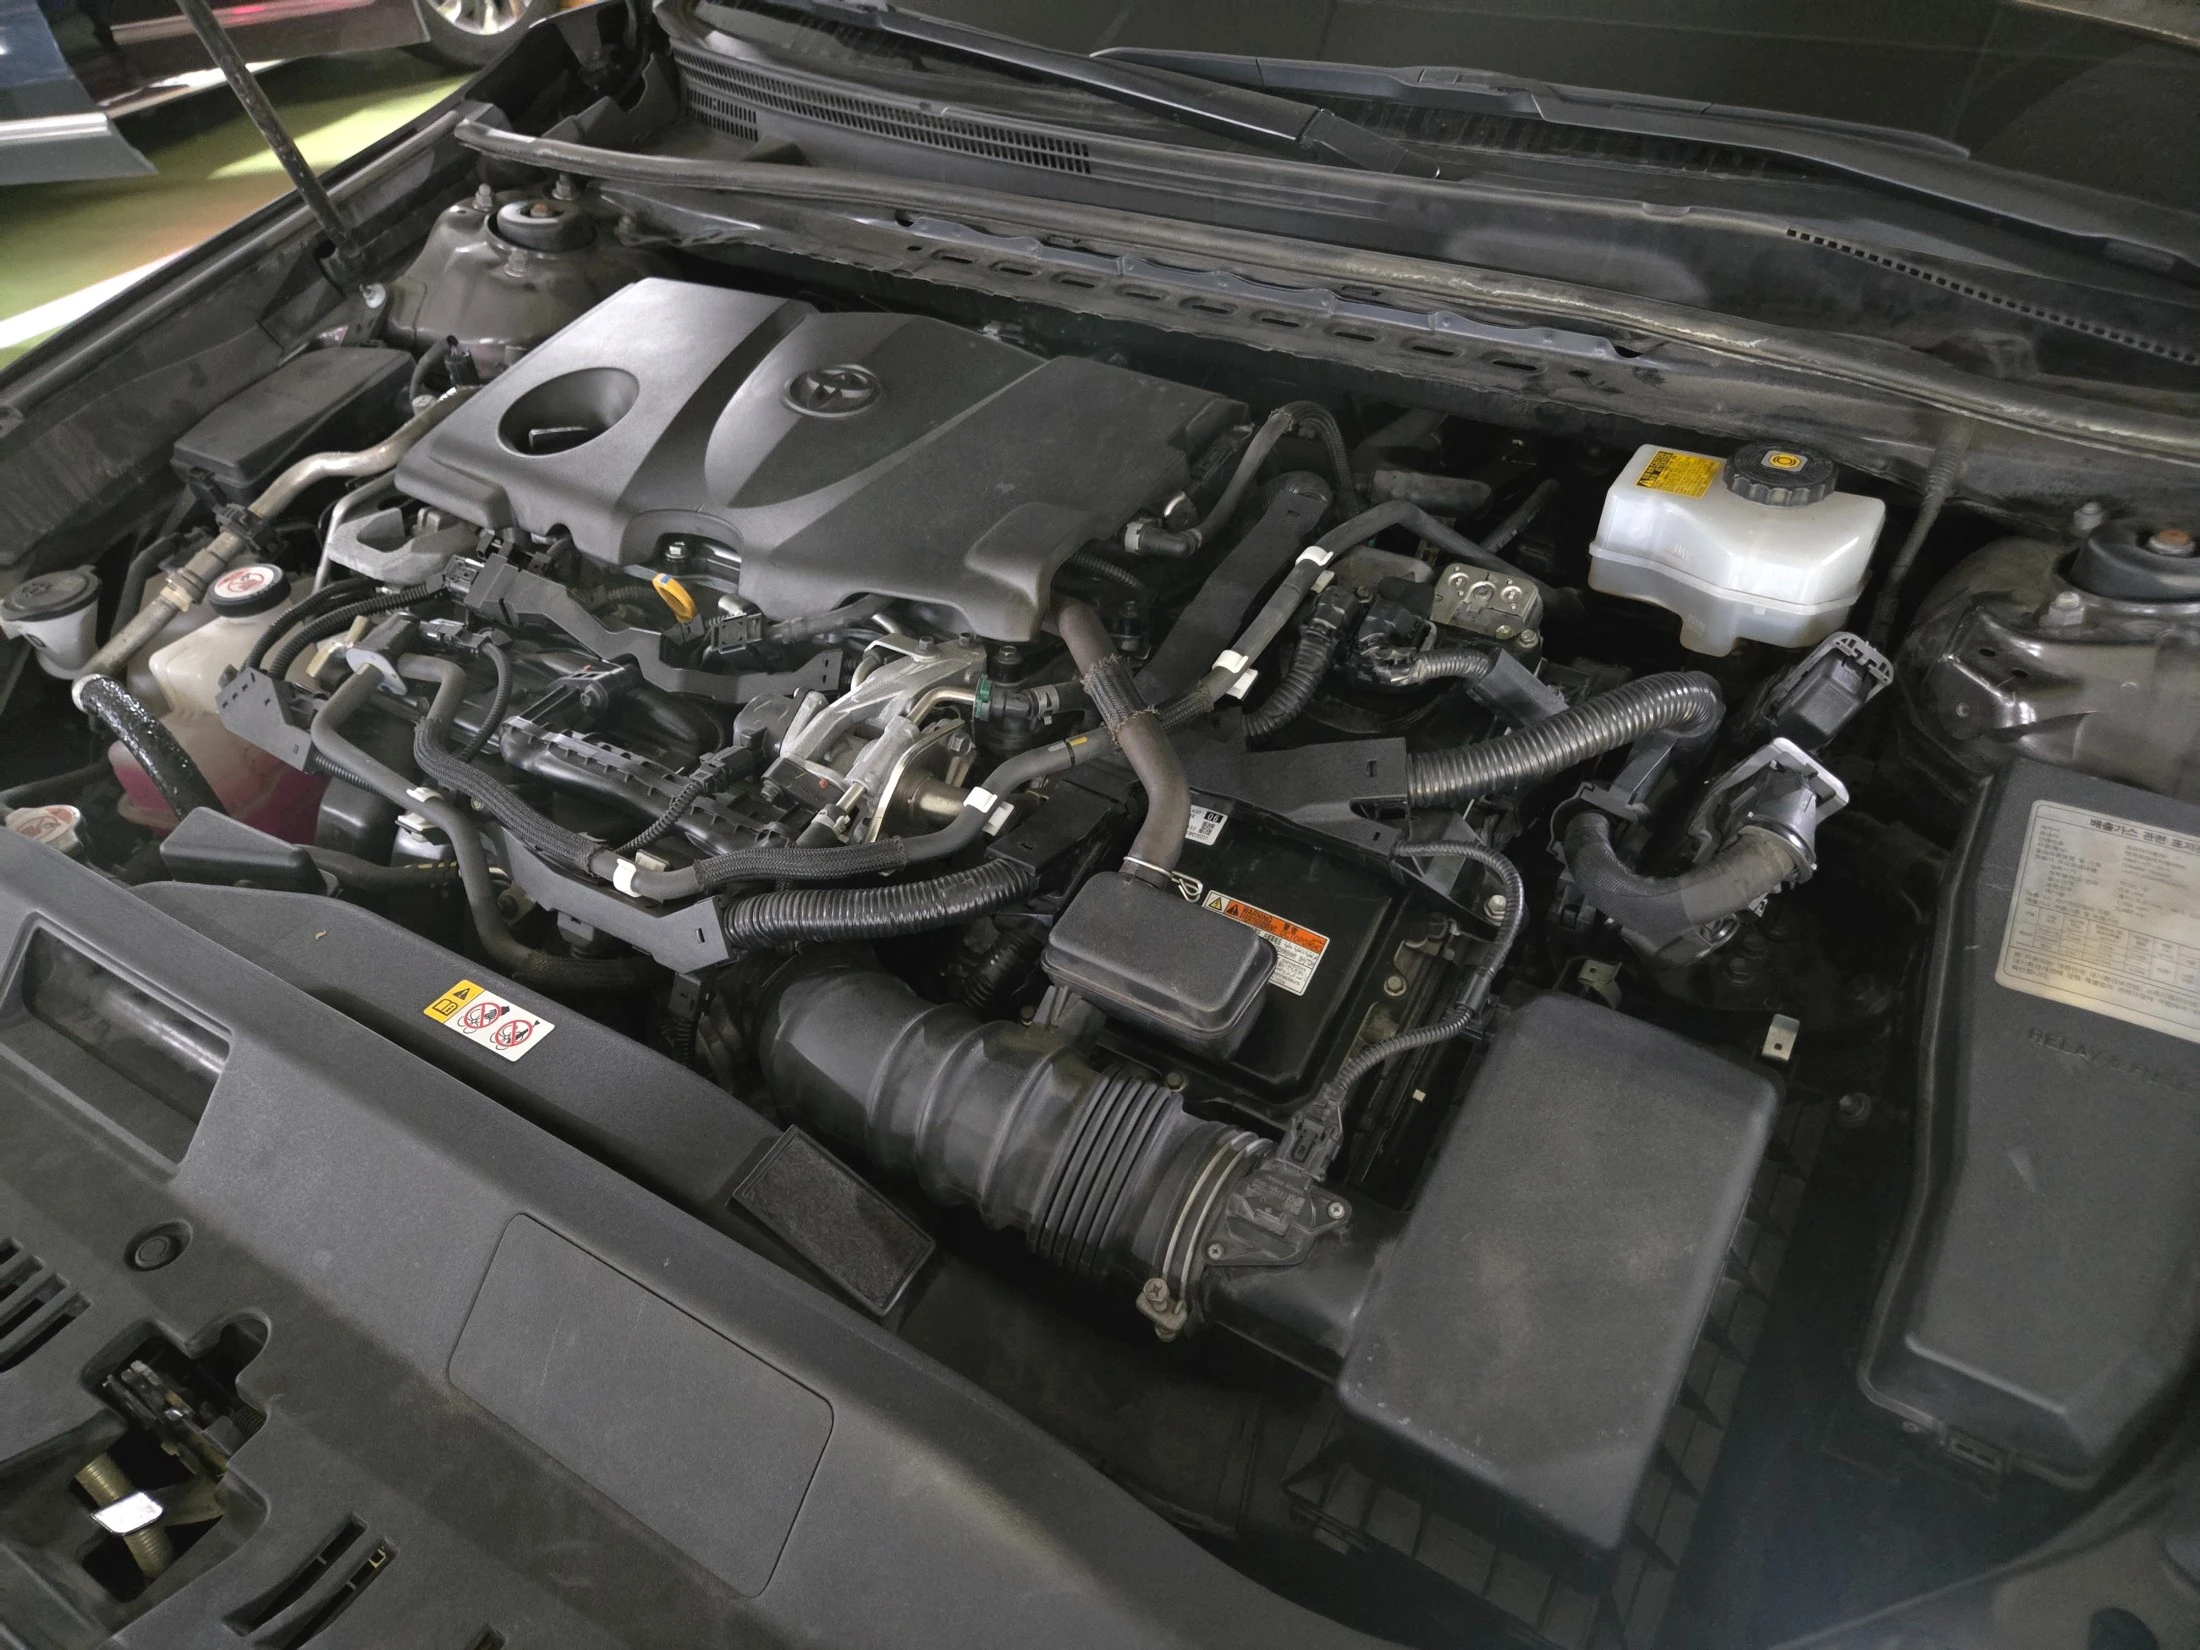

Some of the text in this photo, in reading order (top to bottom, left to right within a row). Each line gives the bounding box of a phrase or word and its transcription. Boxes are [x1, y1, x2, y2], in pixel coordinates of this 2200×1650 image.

[1207, 812, 1220, 823] 06
[2089, 817, 2139, 839] 배출가스
[2142, 831, 2167, 845] 관련
[1242, 904, 1272, 924] WARNING
